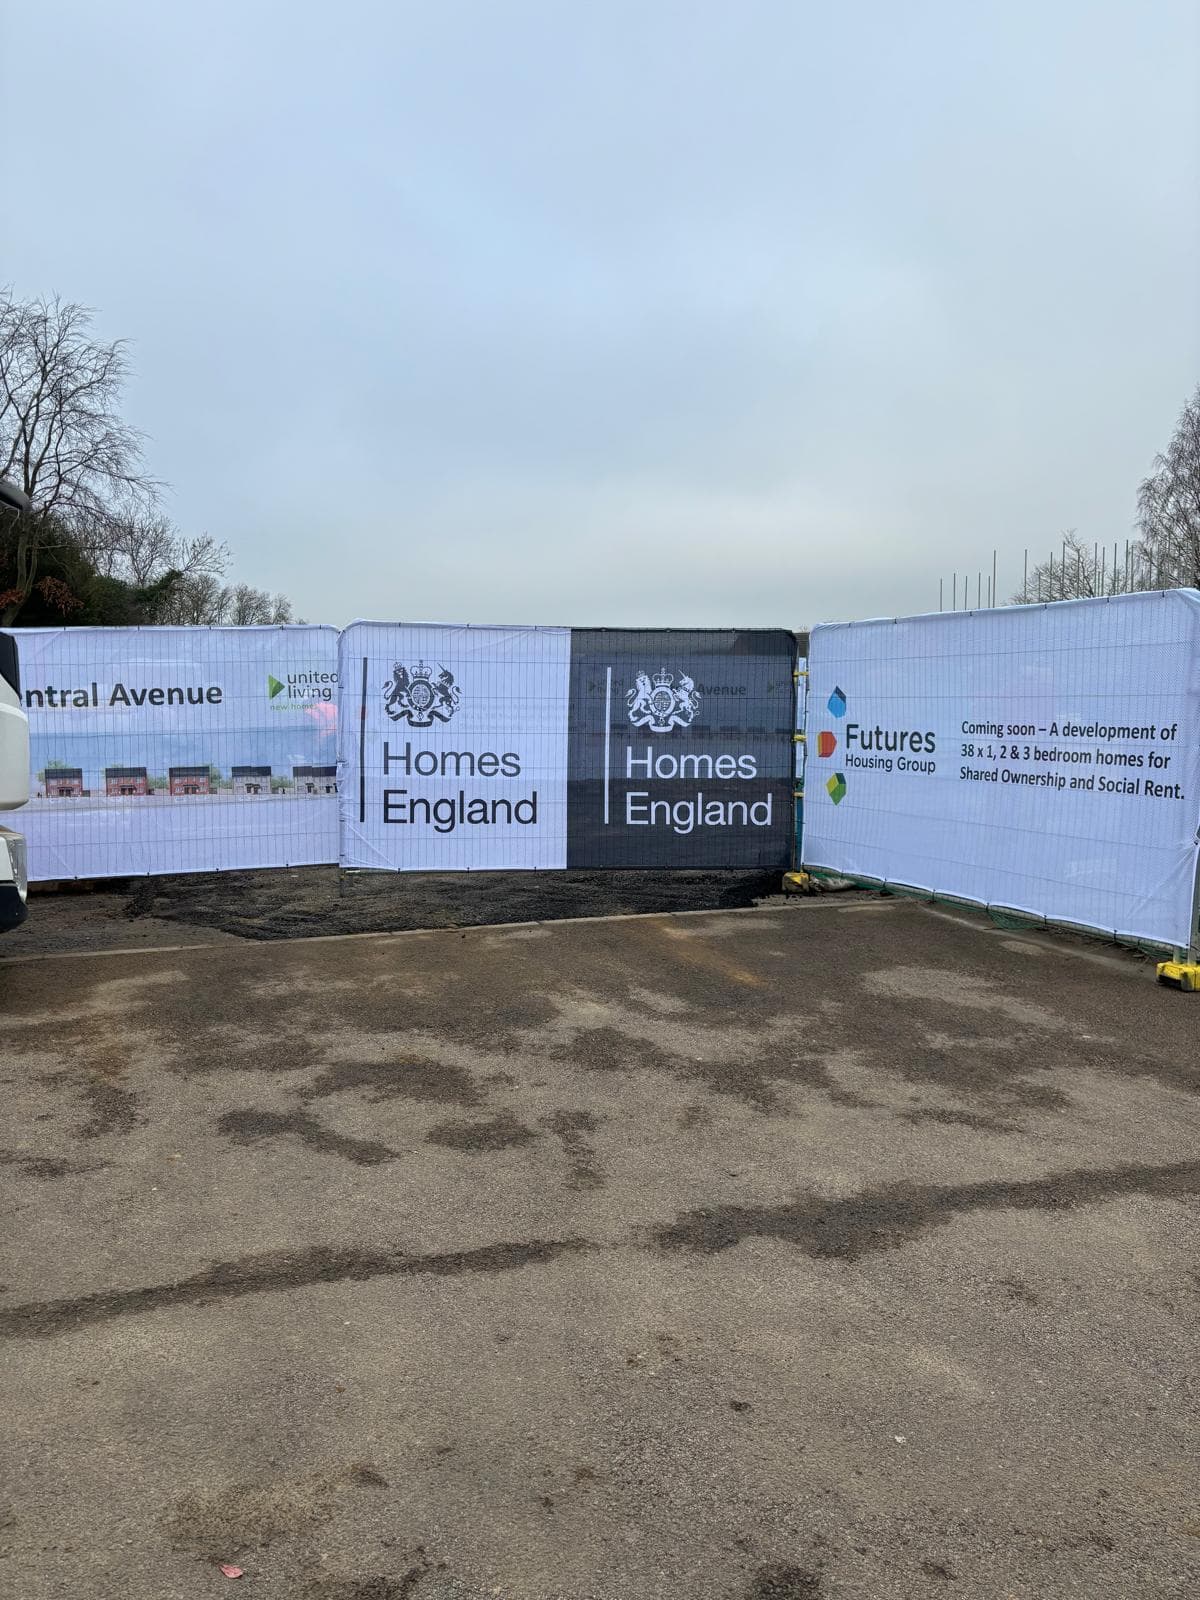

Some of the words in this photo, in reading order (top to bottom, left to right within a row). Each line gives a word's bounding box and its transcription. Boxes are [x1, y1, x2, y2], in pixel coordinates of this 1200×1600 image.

[19, 682, 98, 708] ntral
[109, 682, 223, 708] Avenue
[288, 685, 332, 702] living
[846, 723, 936, 754] Futures
[961, 720, 1004, 738] Coming
[1006, 723, 1036, 737] soon
[1049, 722, 1059, 737] A
[1062, 722, 1157, 742] development
[1160, 723, 1178, 741] of
[383, 741, 522, 778] Homes
[626, 746, 758, 780] Homes
[845, 753, 893, 773] Housing
[897, 756, 936, 775] Group
[960, 744, 975, 758] 38
[977, 747, 984, 758] x
[986, 745, 997, 761] 1,
[999, 745, 1007, 759] 2
[1011, 745, 1020, 760] &
[1023, 746, 1031, 761] 3
[1033, 746, 1092, 764] bedroom
[1096, 749, 1144, 768] homes
[1148, 751, 1171, 769] for
[960, 766, 998, 782] Shared
[1001, 769, 1066, 791] Ownership
[1069, 774, 1095, 791] and
[1098, 776, 1140, 795] Social
[1144, 780, 1185, 800] Rent.
[383, 789, 538, 833] England
[626, 791, 773, 835] England
